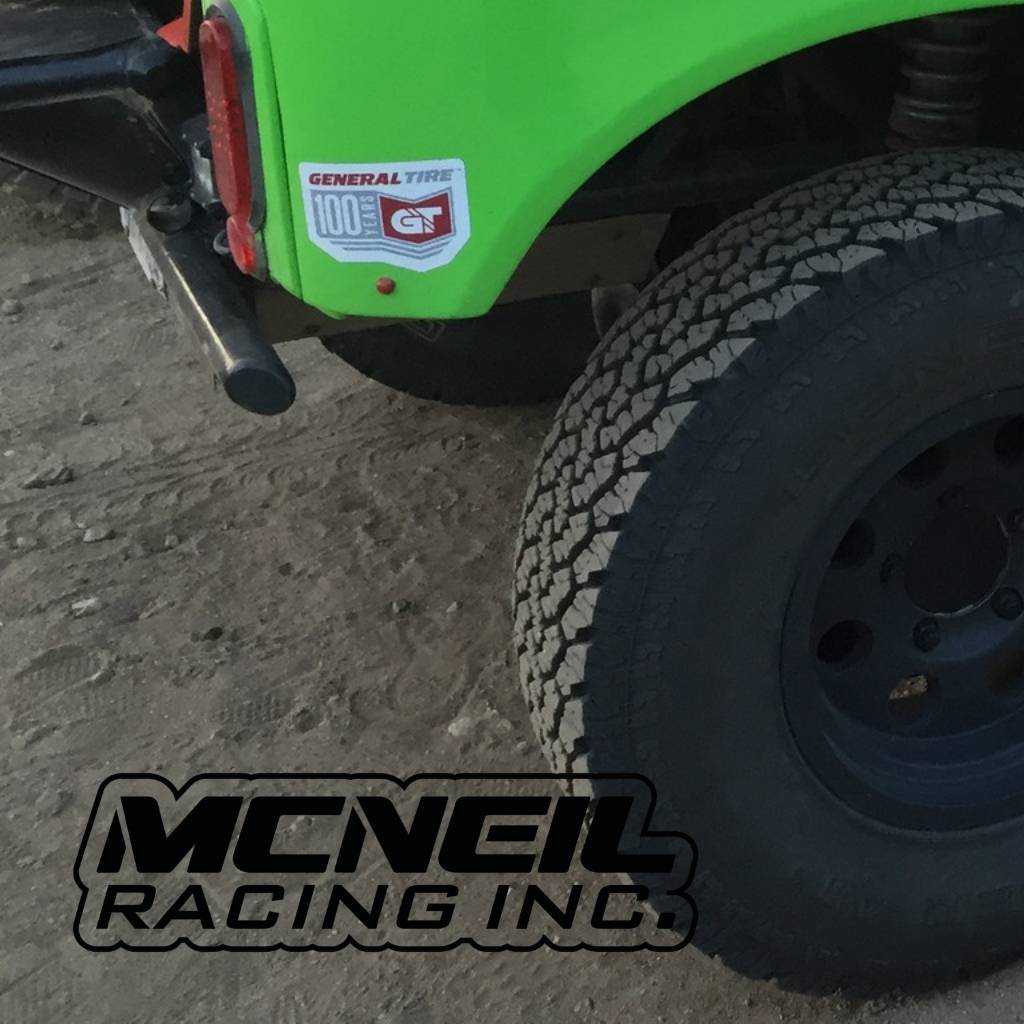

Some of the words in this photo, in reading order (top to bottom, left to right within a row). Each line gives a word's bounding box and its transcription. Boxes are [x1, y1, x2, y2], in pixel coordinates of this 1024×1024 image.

[308, 172, 402, 186] GENERAL
[404, 168, 454, 184] TIRE
[314, 194, 362, 236] 100
[361, 195, 375, 238] YEARS
[390, 206, 443, 234] GT
